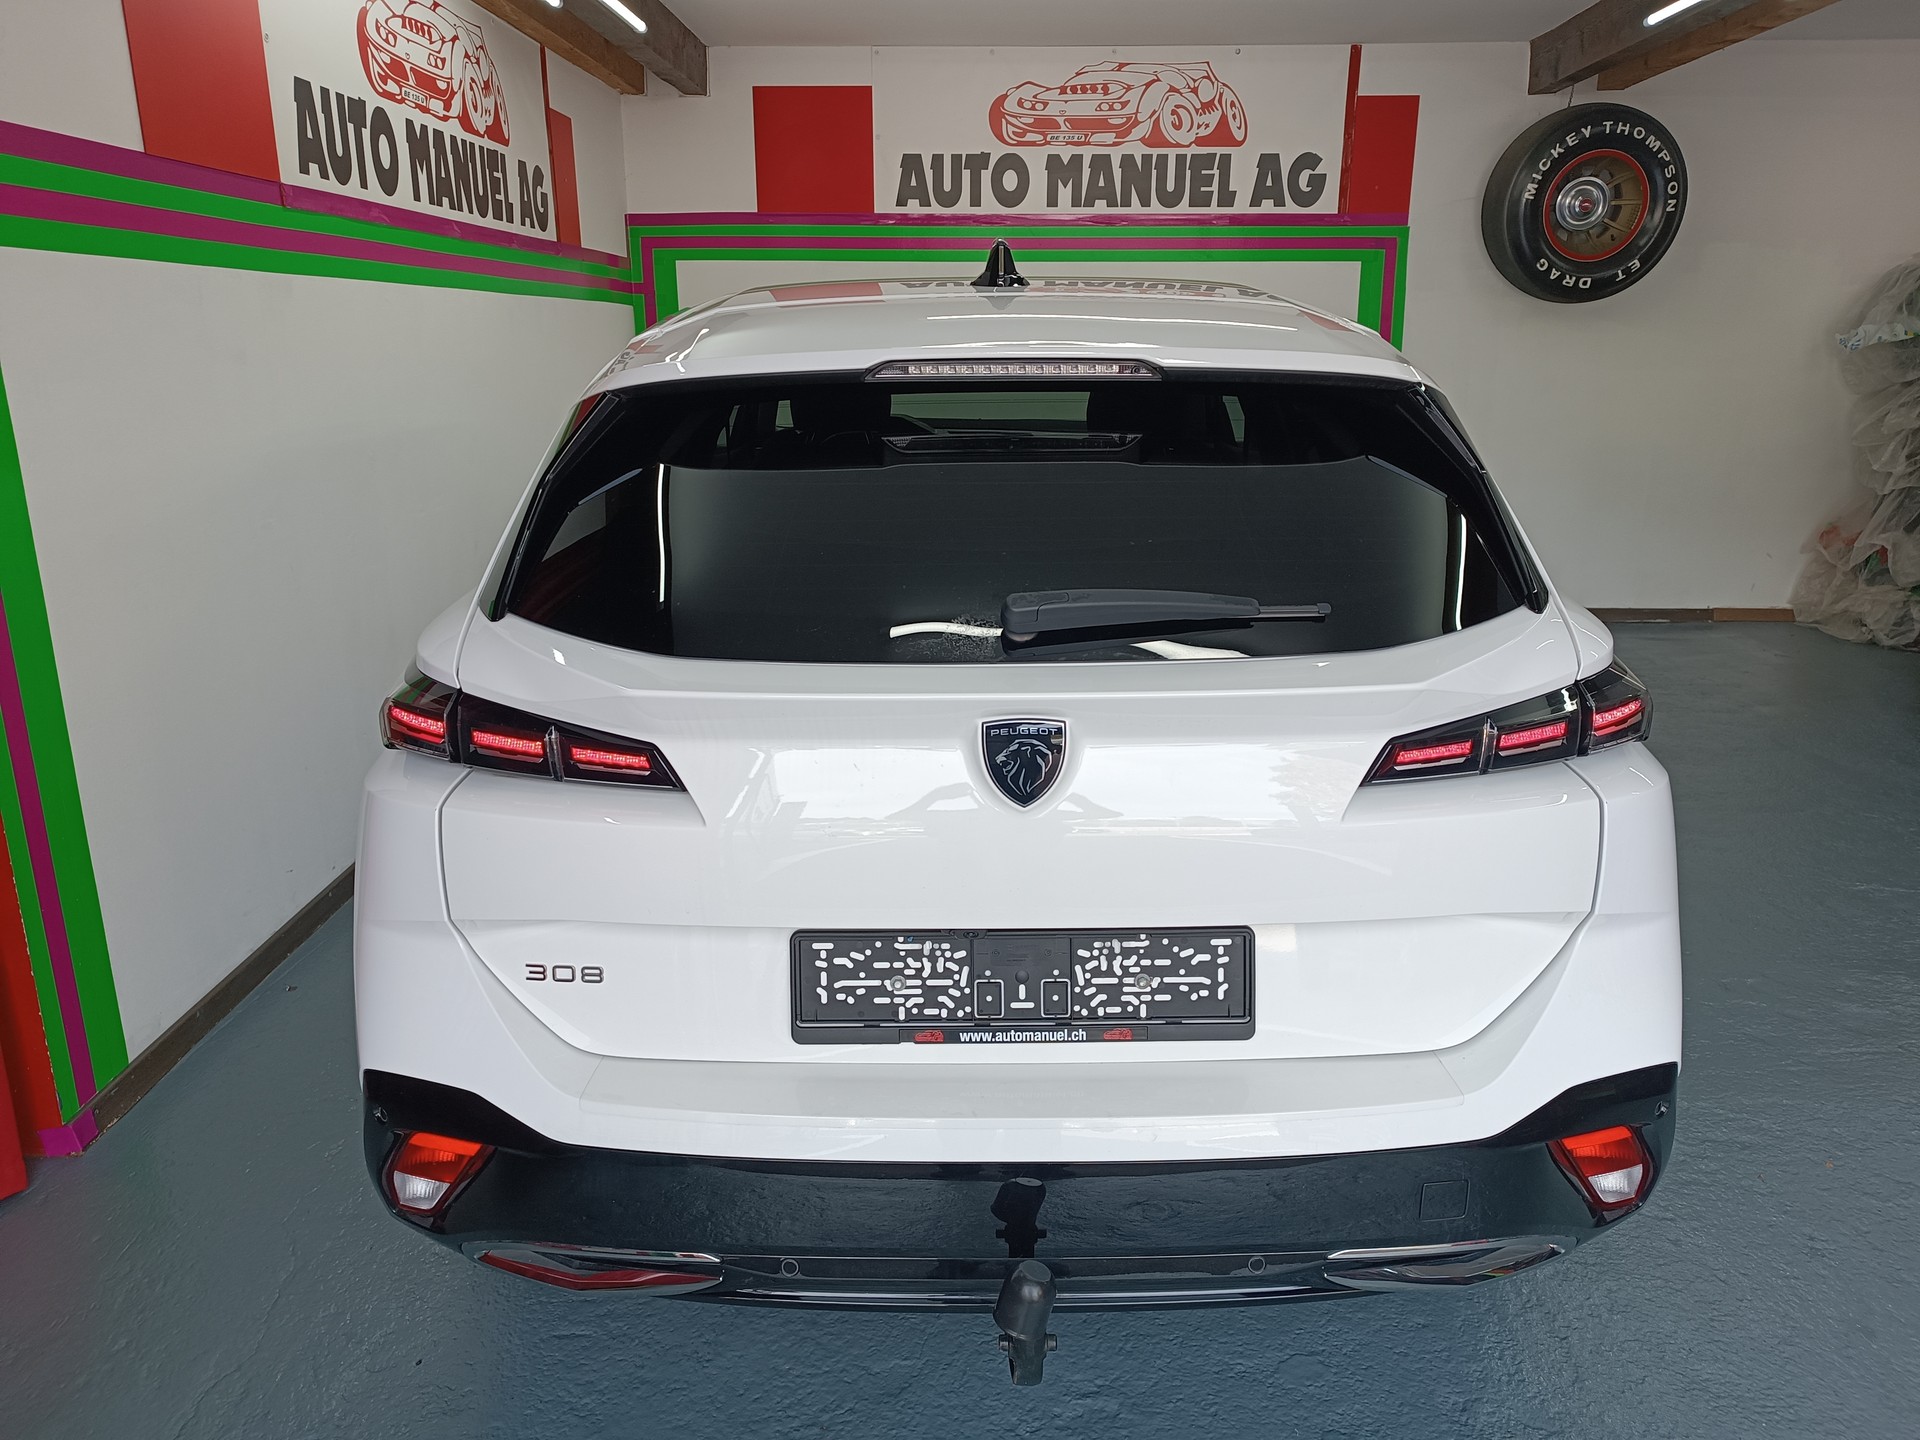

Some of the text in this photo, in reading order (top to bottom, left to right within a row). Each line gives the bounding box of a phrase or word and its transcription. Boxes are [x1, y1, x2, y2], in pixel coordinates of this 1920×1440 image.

[294, 76, 549, 232] AUTO MANUEL AG
[1524, 121, 1679, 213] MICKEY THOMPSON
[895, 151, 1328, 208] AUTO MANUEL AG
[1536, 258, 1641, 289] ET DRAG
[990, 727, 1058, 736] PEUGEOT
[525, 963, 604, 984] 308
[959, 1029, 1087, 1042] www.automanuel.ch
